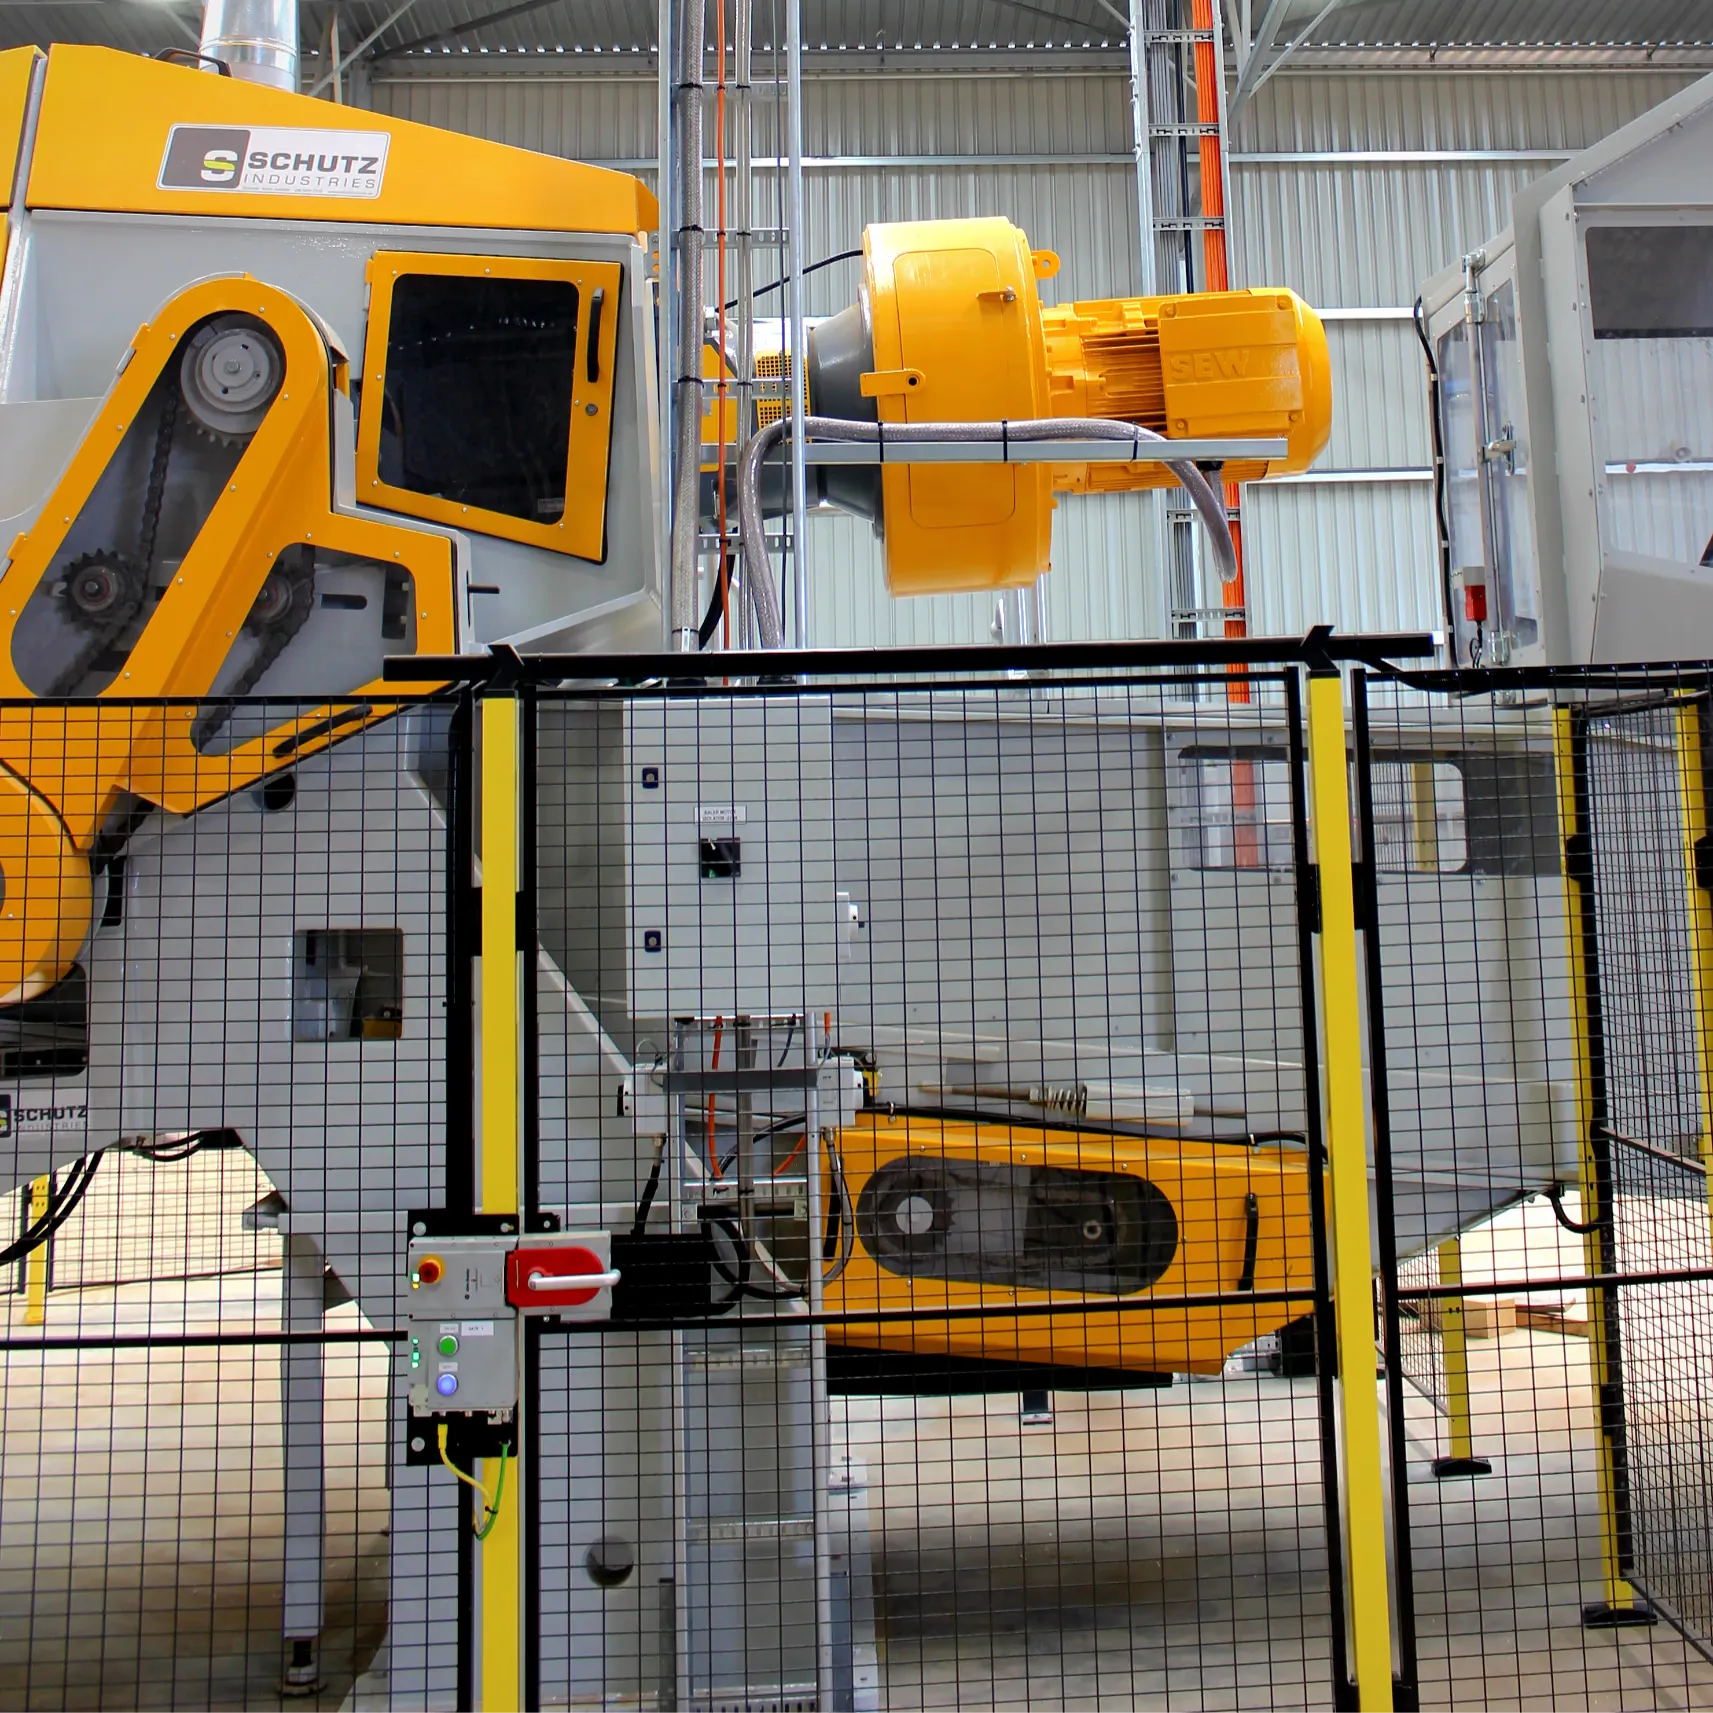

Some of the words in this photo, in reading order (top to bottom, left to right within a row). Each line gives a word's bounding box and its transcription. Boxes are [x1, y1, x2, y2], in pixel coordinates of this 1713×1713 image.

[247, 151, 379, 175] SCHUTZ
[243, 173, 376, 189] INDUSTRIES
[1169, 349, 1250, 381] SEW
[13, 1105, 88, 1122] SCHUTZ
